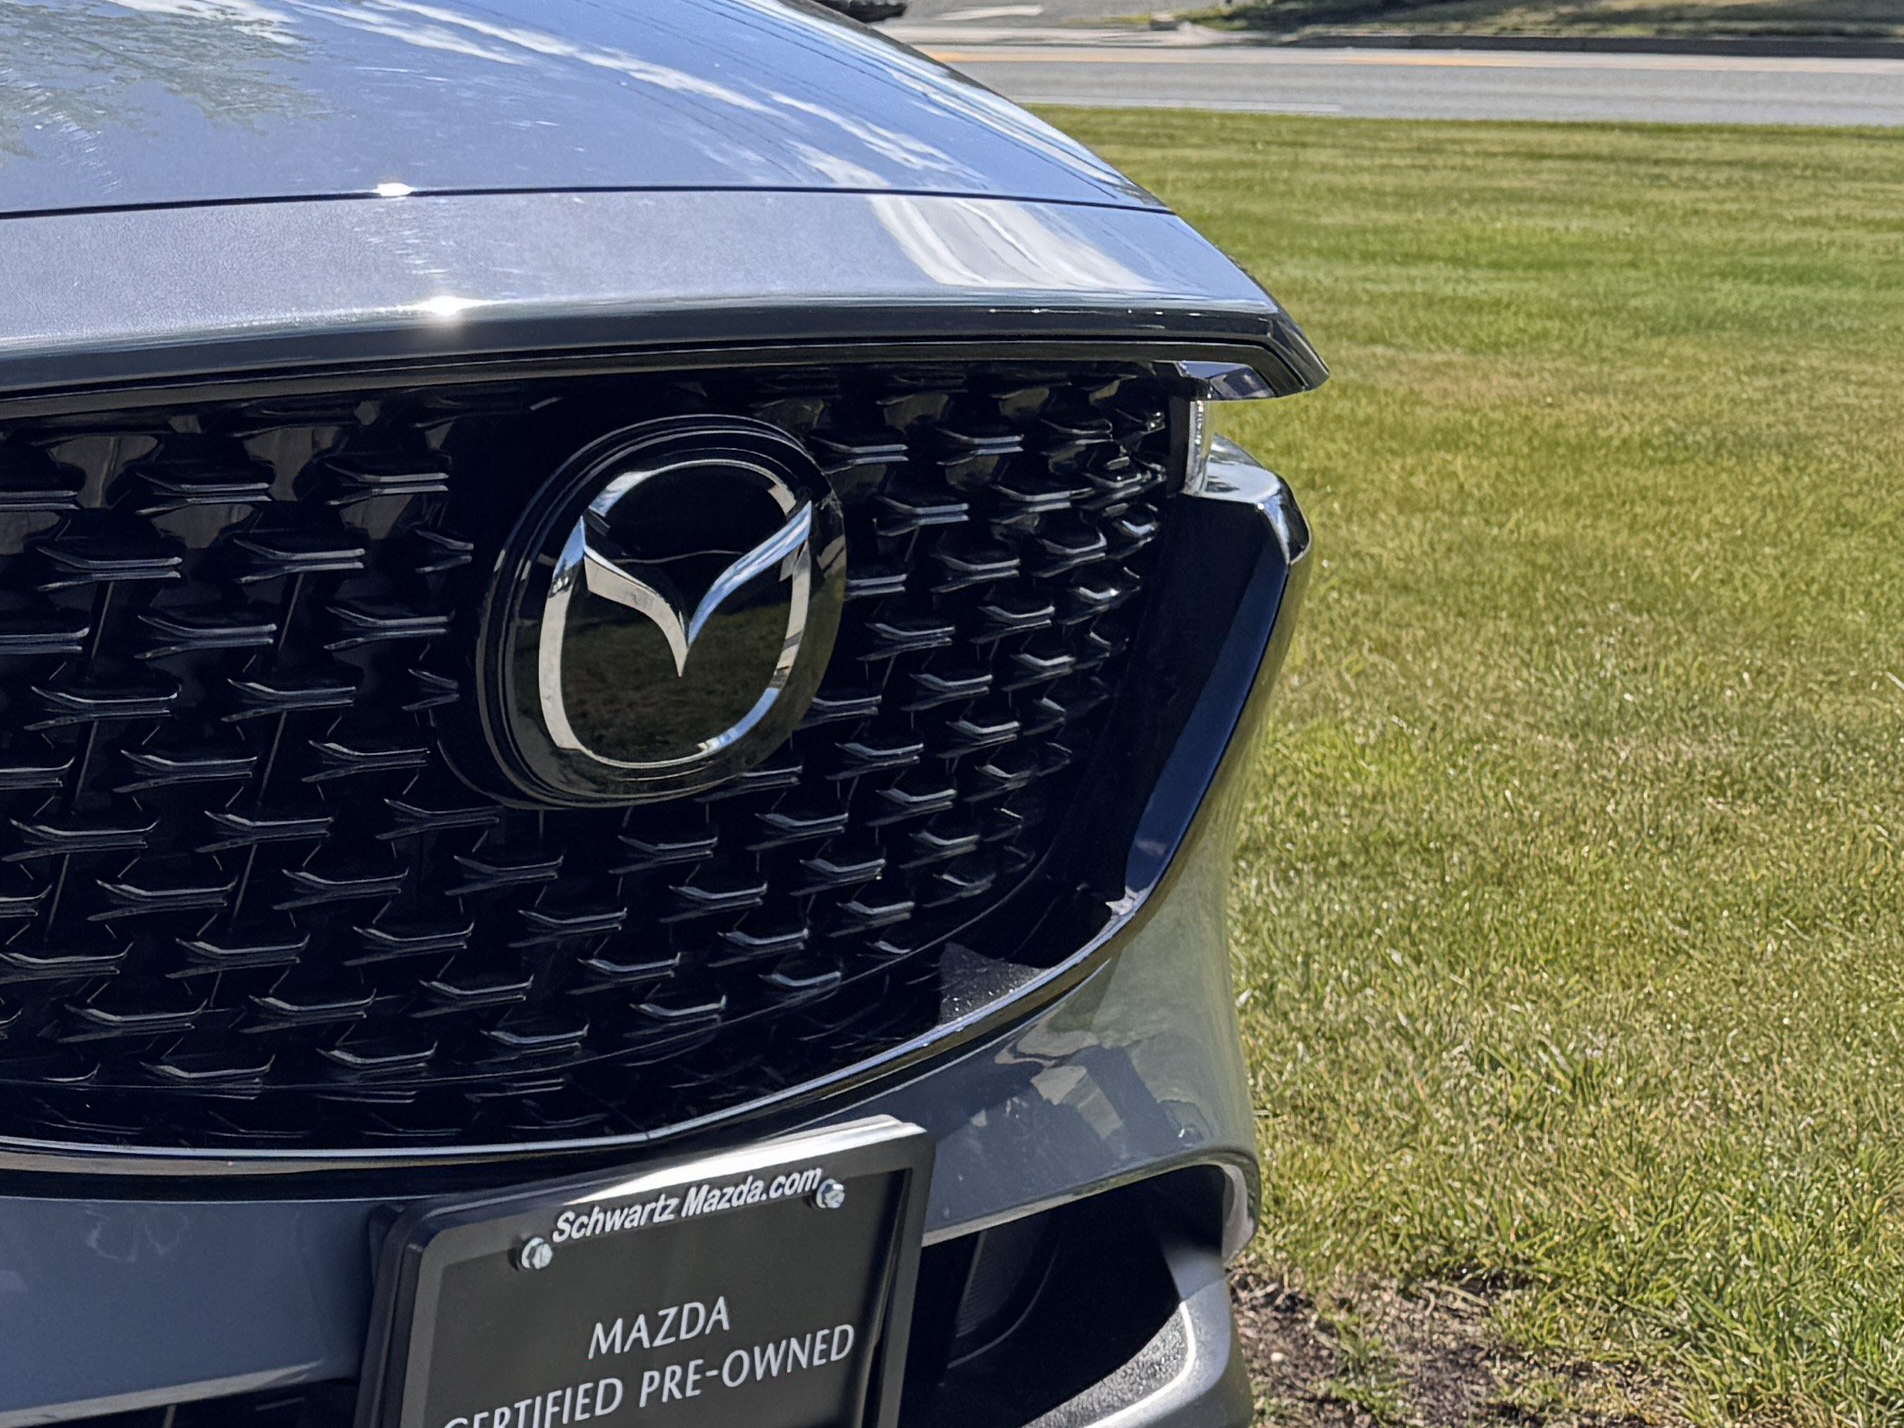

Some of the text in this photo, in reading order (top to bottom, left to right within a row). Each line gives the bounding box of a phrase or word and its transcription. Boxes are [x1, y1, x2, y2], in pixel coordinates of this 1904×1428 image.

[552, 1167, 824, 1243] Schwartz Mazda.com
[588, 1295, 731, 1360] MAZDA
[639, 1323, 855, 1408] PRE-OWNED
